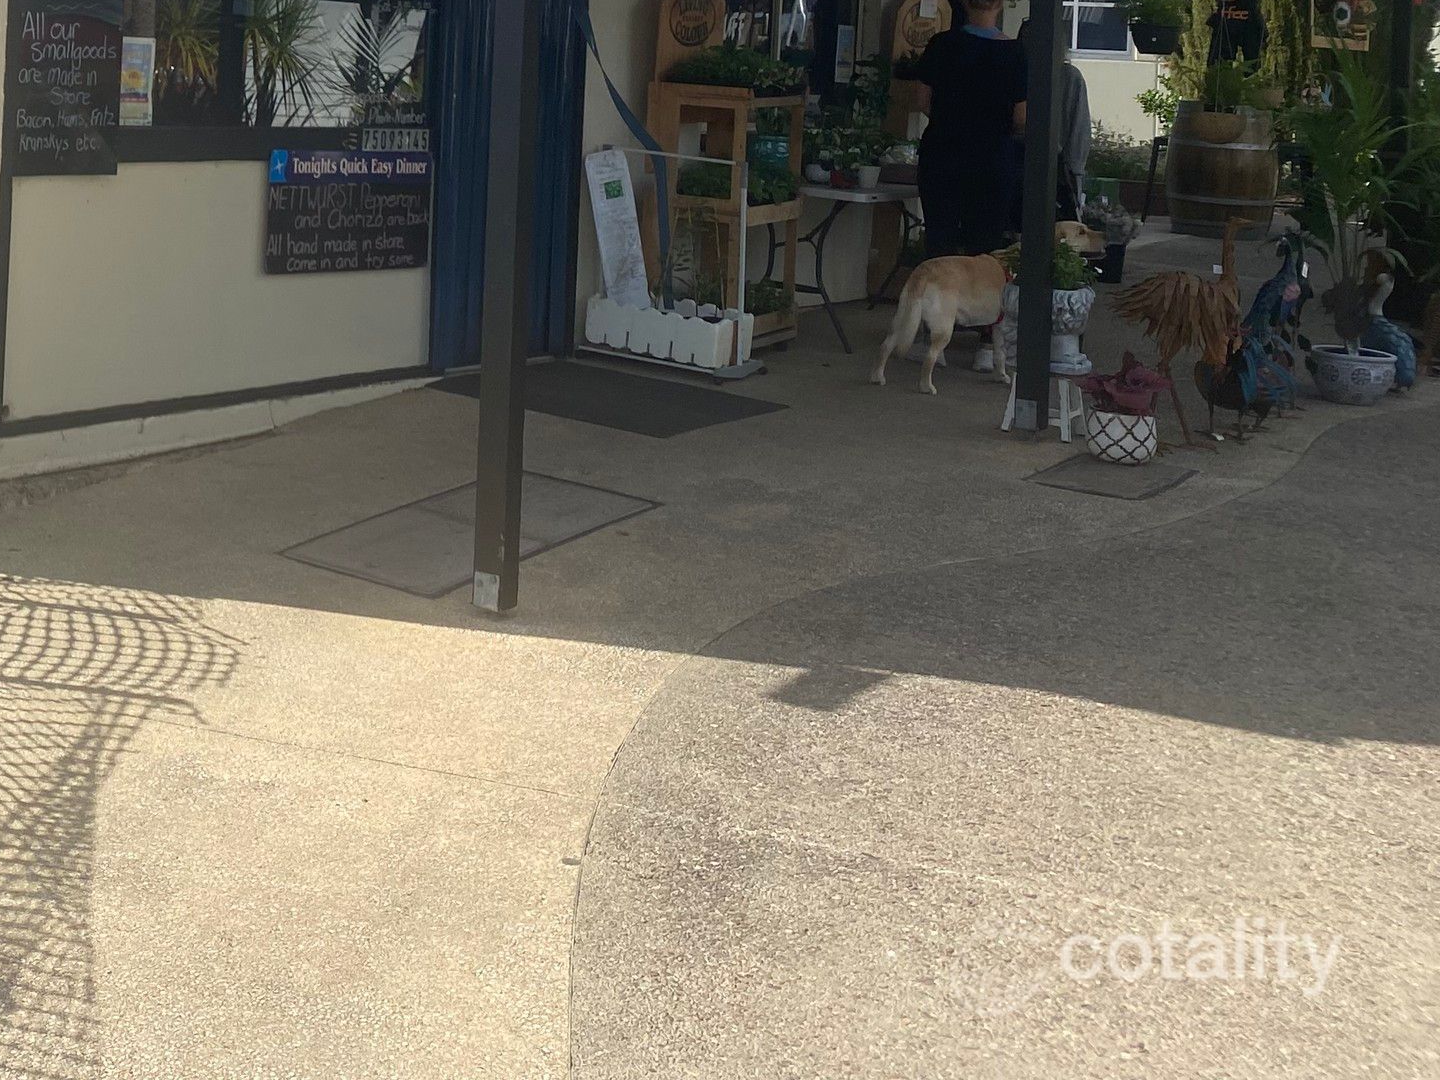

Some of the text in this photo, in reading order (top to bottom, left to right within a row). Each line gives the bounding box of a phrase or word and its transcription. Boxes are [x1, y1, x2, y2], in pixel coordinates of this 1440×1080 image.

[21, 10, 80, 40] All our
[30, 35, 117, 68] Smallgoods
[18, 68, 42, 84] are
[86, 70, 97, 86] in
[292, 157, 427, 178] Tonights Quick Easy Dinner
[294, 209, 321, 230] and
[266, 233, 282, 256] All
[287, 232, 318, 256] hand
[323, 232, 357, 253] made
[362, 239, 372, 251] in
[320, 258, 331, 270] in
[335, 251, 358, 270] and
